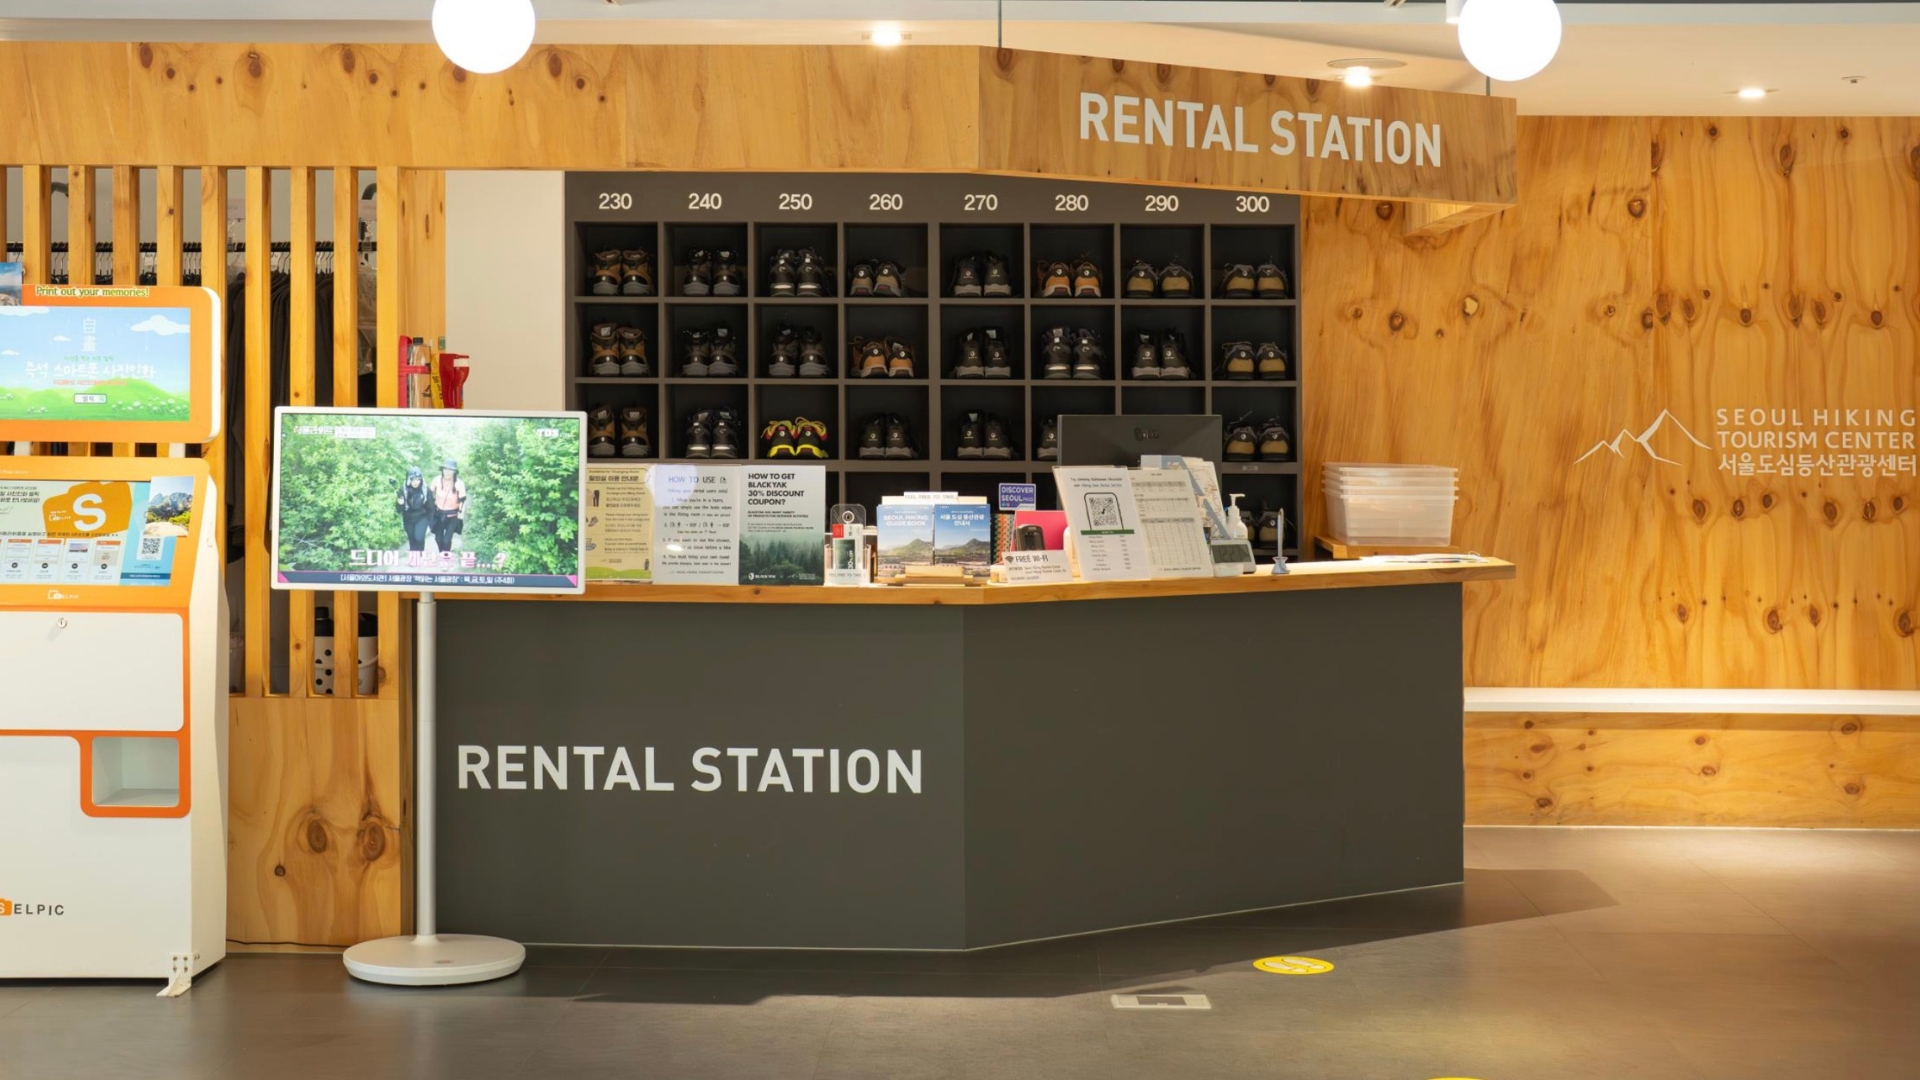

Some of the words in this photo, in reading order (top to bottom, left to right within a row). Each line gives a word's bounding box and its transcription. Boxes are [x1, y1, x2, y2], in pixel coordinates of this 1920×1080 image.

[1080, 92, 1258, 153] RENTAL
[1270, 110, 1440, 168] STATION
[598, 194, 632, 210] 230
[688, 194, 722, 210] 240
[778, 194, 813, 210] 250
[869, 194, 904, 210] 260
[964, 194, 998, 211] 270
[1054, 195, 1089, 211] 280
[1145, 195, 1179, 212] 290
[1236, 196, 1270, 212] 300
[36, 287, 58, 296] Print
[80, 288, 99, 297] your
[102, 288, 149, 296] memories!
[26, 361, 49, 378] 즉석
[54, 362, 98, 378] 스마트폰
[1716, 408, 1803, 426] SEOUL
[1814, 408, 1916, 426] HIKING
[1717, 431, 1817, 449] TOURISM
[1824, 431, 1915, 449] CENTER
[1718, 452, 1917, 478] 서울도심등산관광센터
[73, 493, 106, 531] S
[458, 744, 674, 792] RENTAL
[690, 746, 921, 794] STATION
